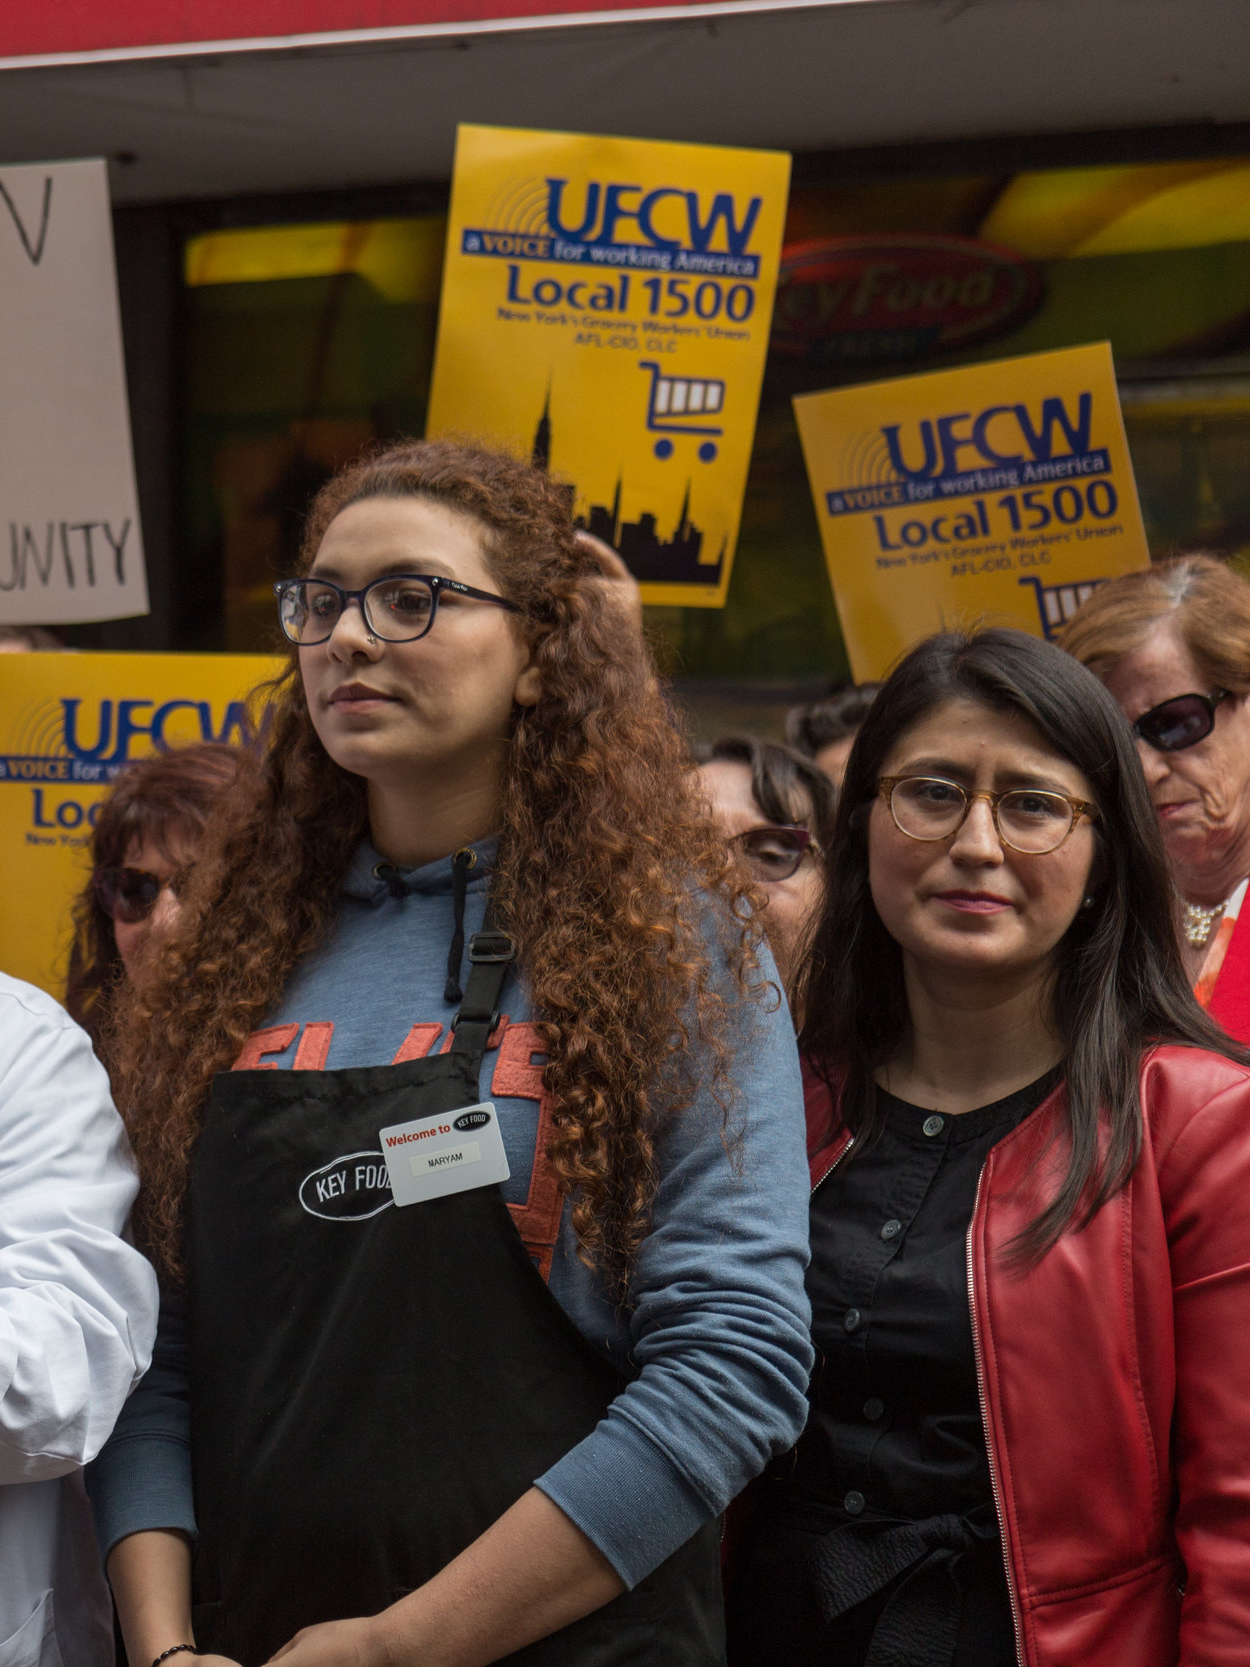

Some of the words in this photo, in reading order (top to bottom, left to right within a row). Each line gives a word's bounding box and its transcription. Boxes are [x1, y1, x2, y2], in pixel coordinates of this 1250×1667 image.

[546, 178, 762, 256] UFCW
[465, 236, 481, 251] a
[482, 235, 549, 257] VOICE
[553, 239, 586, 259] for
[589, 244, 671, 272] working
[674, 250, 755, 276] America
[506, 264, 631, 314] Local
[643, 277, 756, 323] 1500
[881, 392, 1093, 479] UFCW
[845, 486, 904, 511] VOICE
[907, 478, 936, 501] for
[940, 465, 1020, 497] working
[1022, 455, 1105, 485] America
[874, 500, 989, 551] Local
[999, 480, 1119, 533] 1500
[60, 699, 274, 765] UFCW
[7, 761, 69, 779] VOICE
[72, 761, 103, 779] for
[32, 788, 104, 829] Loc
[385, 1128, 437, 1148] Welcome
[438, 1124, 451, 1137] to
[456, 1115, 470, 1128] KEY
[470, 1113, 487, 1126] FOOD
[428, 1152, 463, 1168] MARYAM
[315, 1170, 347, 1203] KEY
